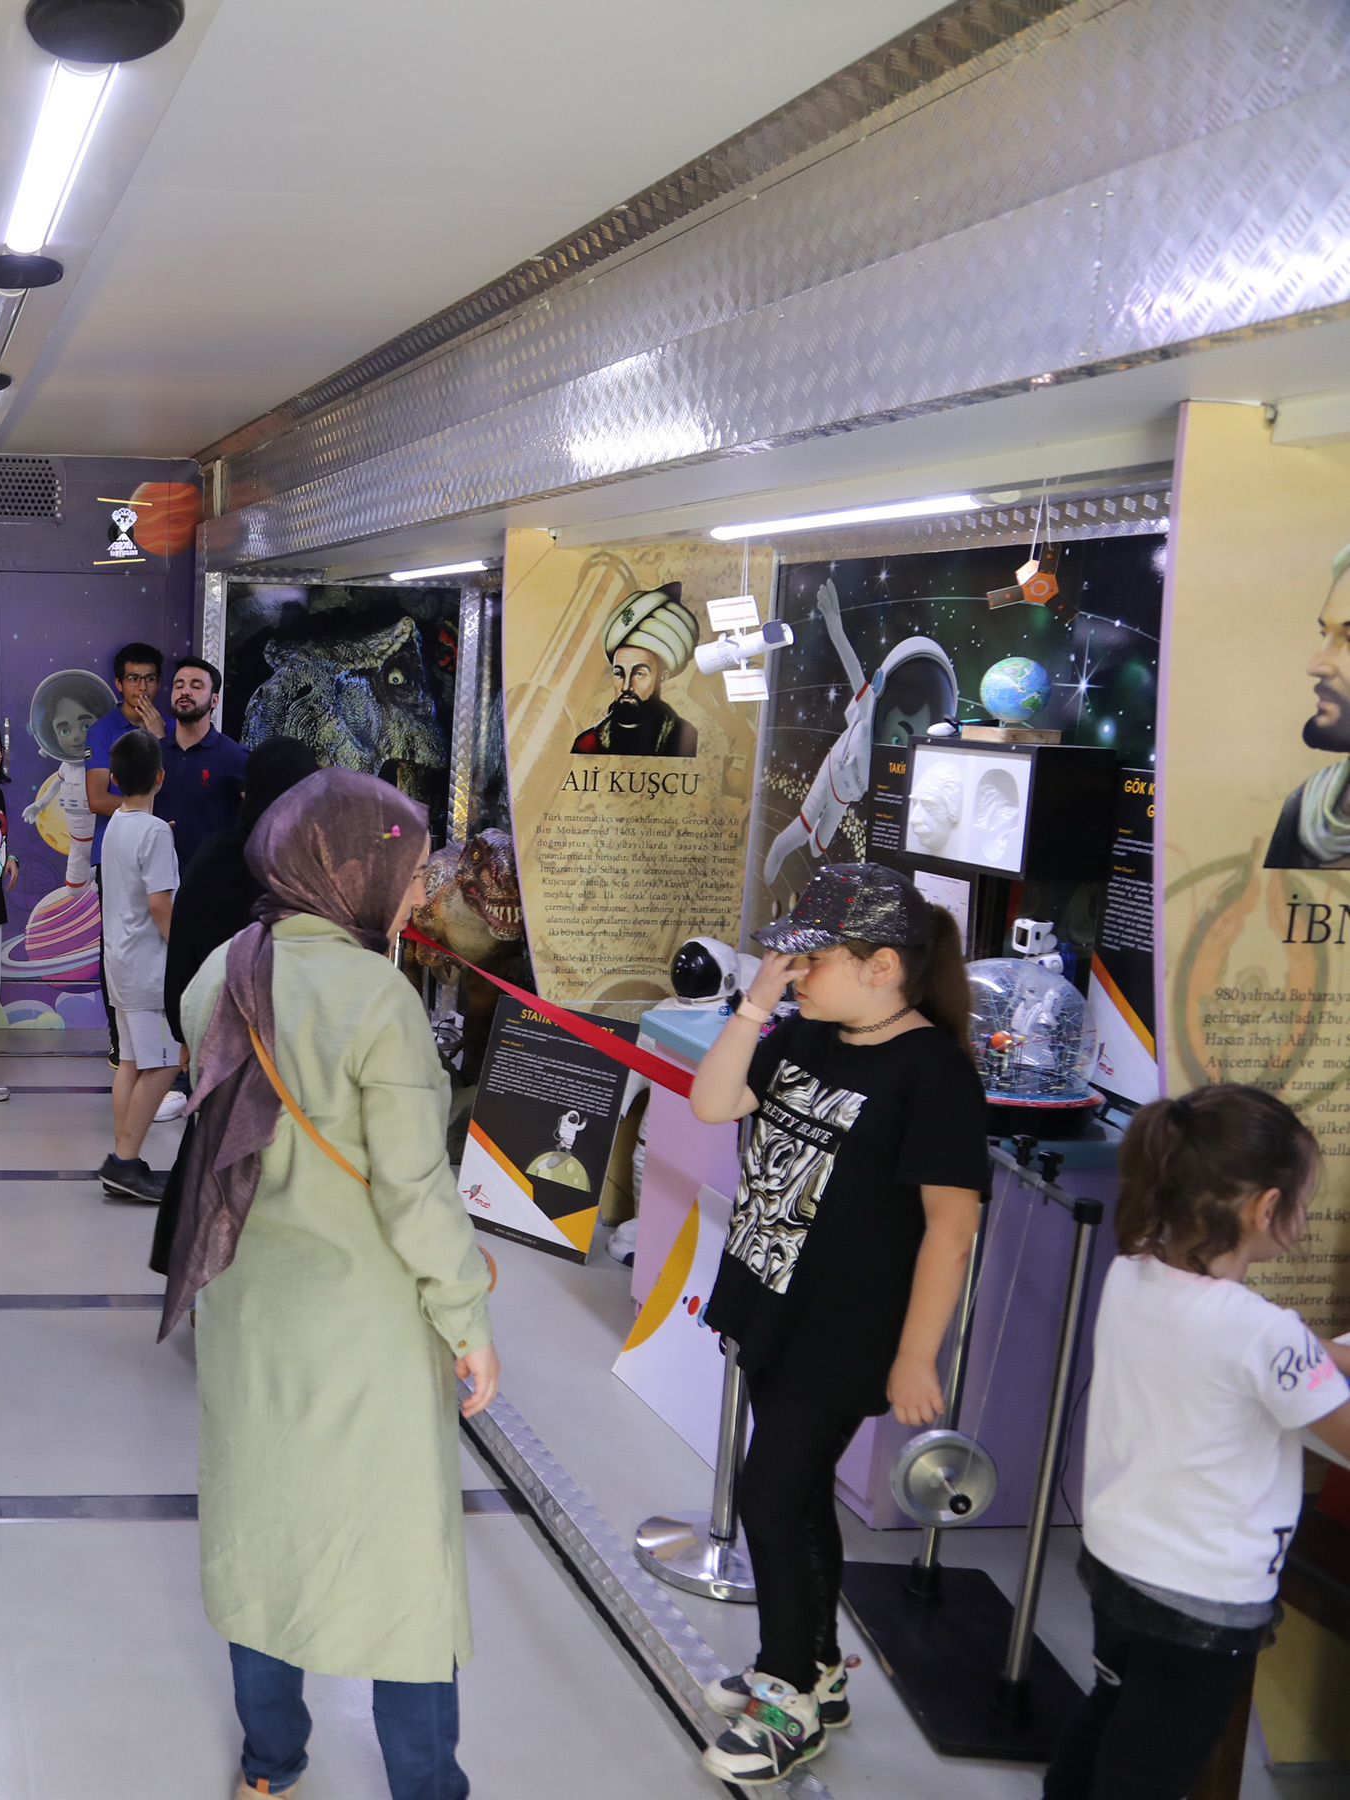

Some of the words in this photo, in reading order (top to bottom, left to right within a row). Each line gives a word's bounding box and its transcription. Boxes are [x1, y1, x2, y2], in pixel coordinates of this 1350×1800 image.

[608, 771, 700, 800] KUŞCU
[1124, 778, 1147, 795] GÖK
[615, 827, 636, 836] 1403
[1215, 987, 1239, 1001] 980
[1205, 1032, 1245, 1046] Hasan
[1323, 1056, 1350, 1069] mod
[1317, 1100, 1350, 1113] olara
[1310, 1253, 1350, 1264] tutma
